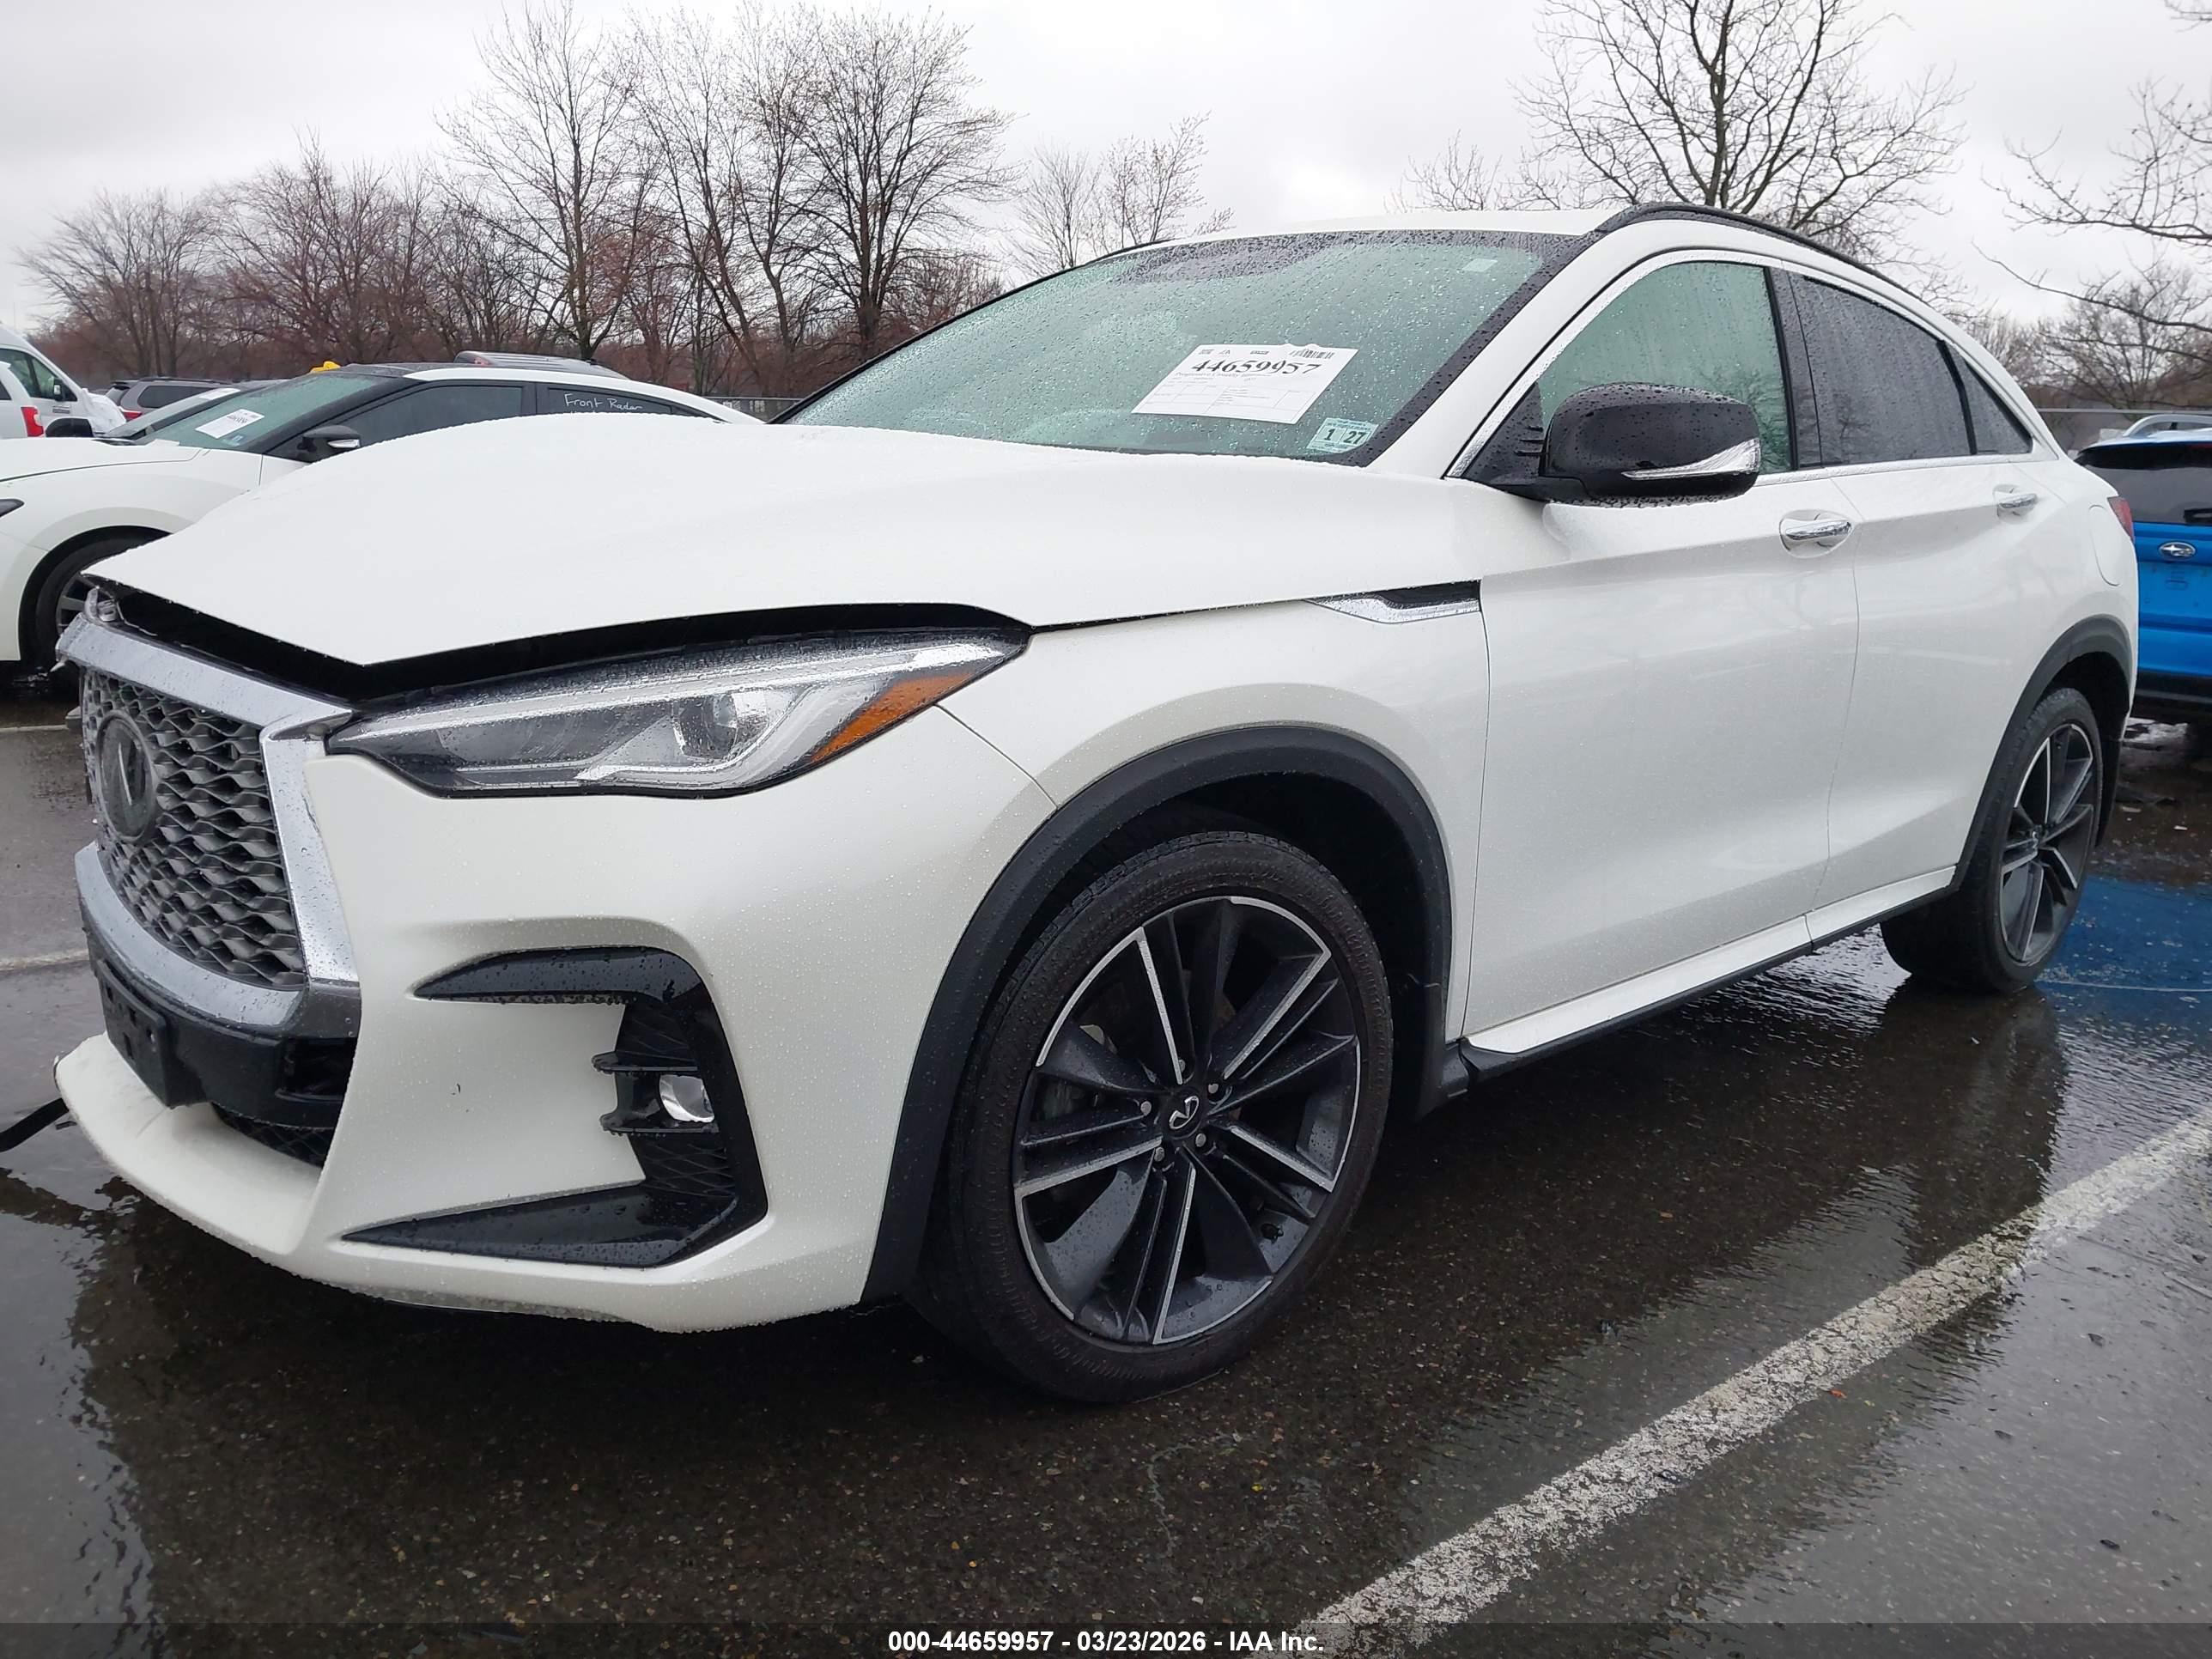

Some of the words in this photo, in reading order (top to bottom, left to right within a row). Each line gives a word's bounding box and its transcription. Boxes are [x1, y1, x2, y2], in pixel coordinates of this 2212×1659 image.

[1191, 359, 1321, 374] 44659957
[564, 393, 603, 408] Front
[606, 398, 643, 410] Radar
[1324, 428, 1335, 441] 1
[1343, 430, 1367, 444] 27
